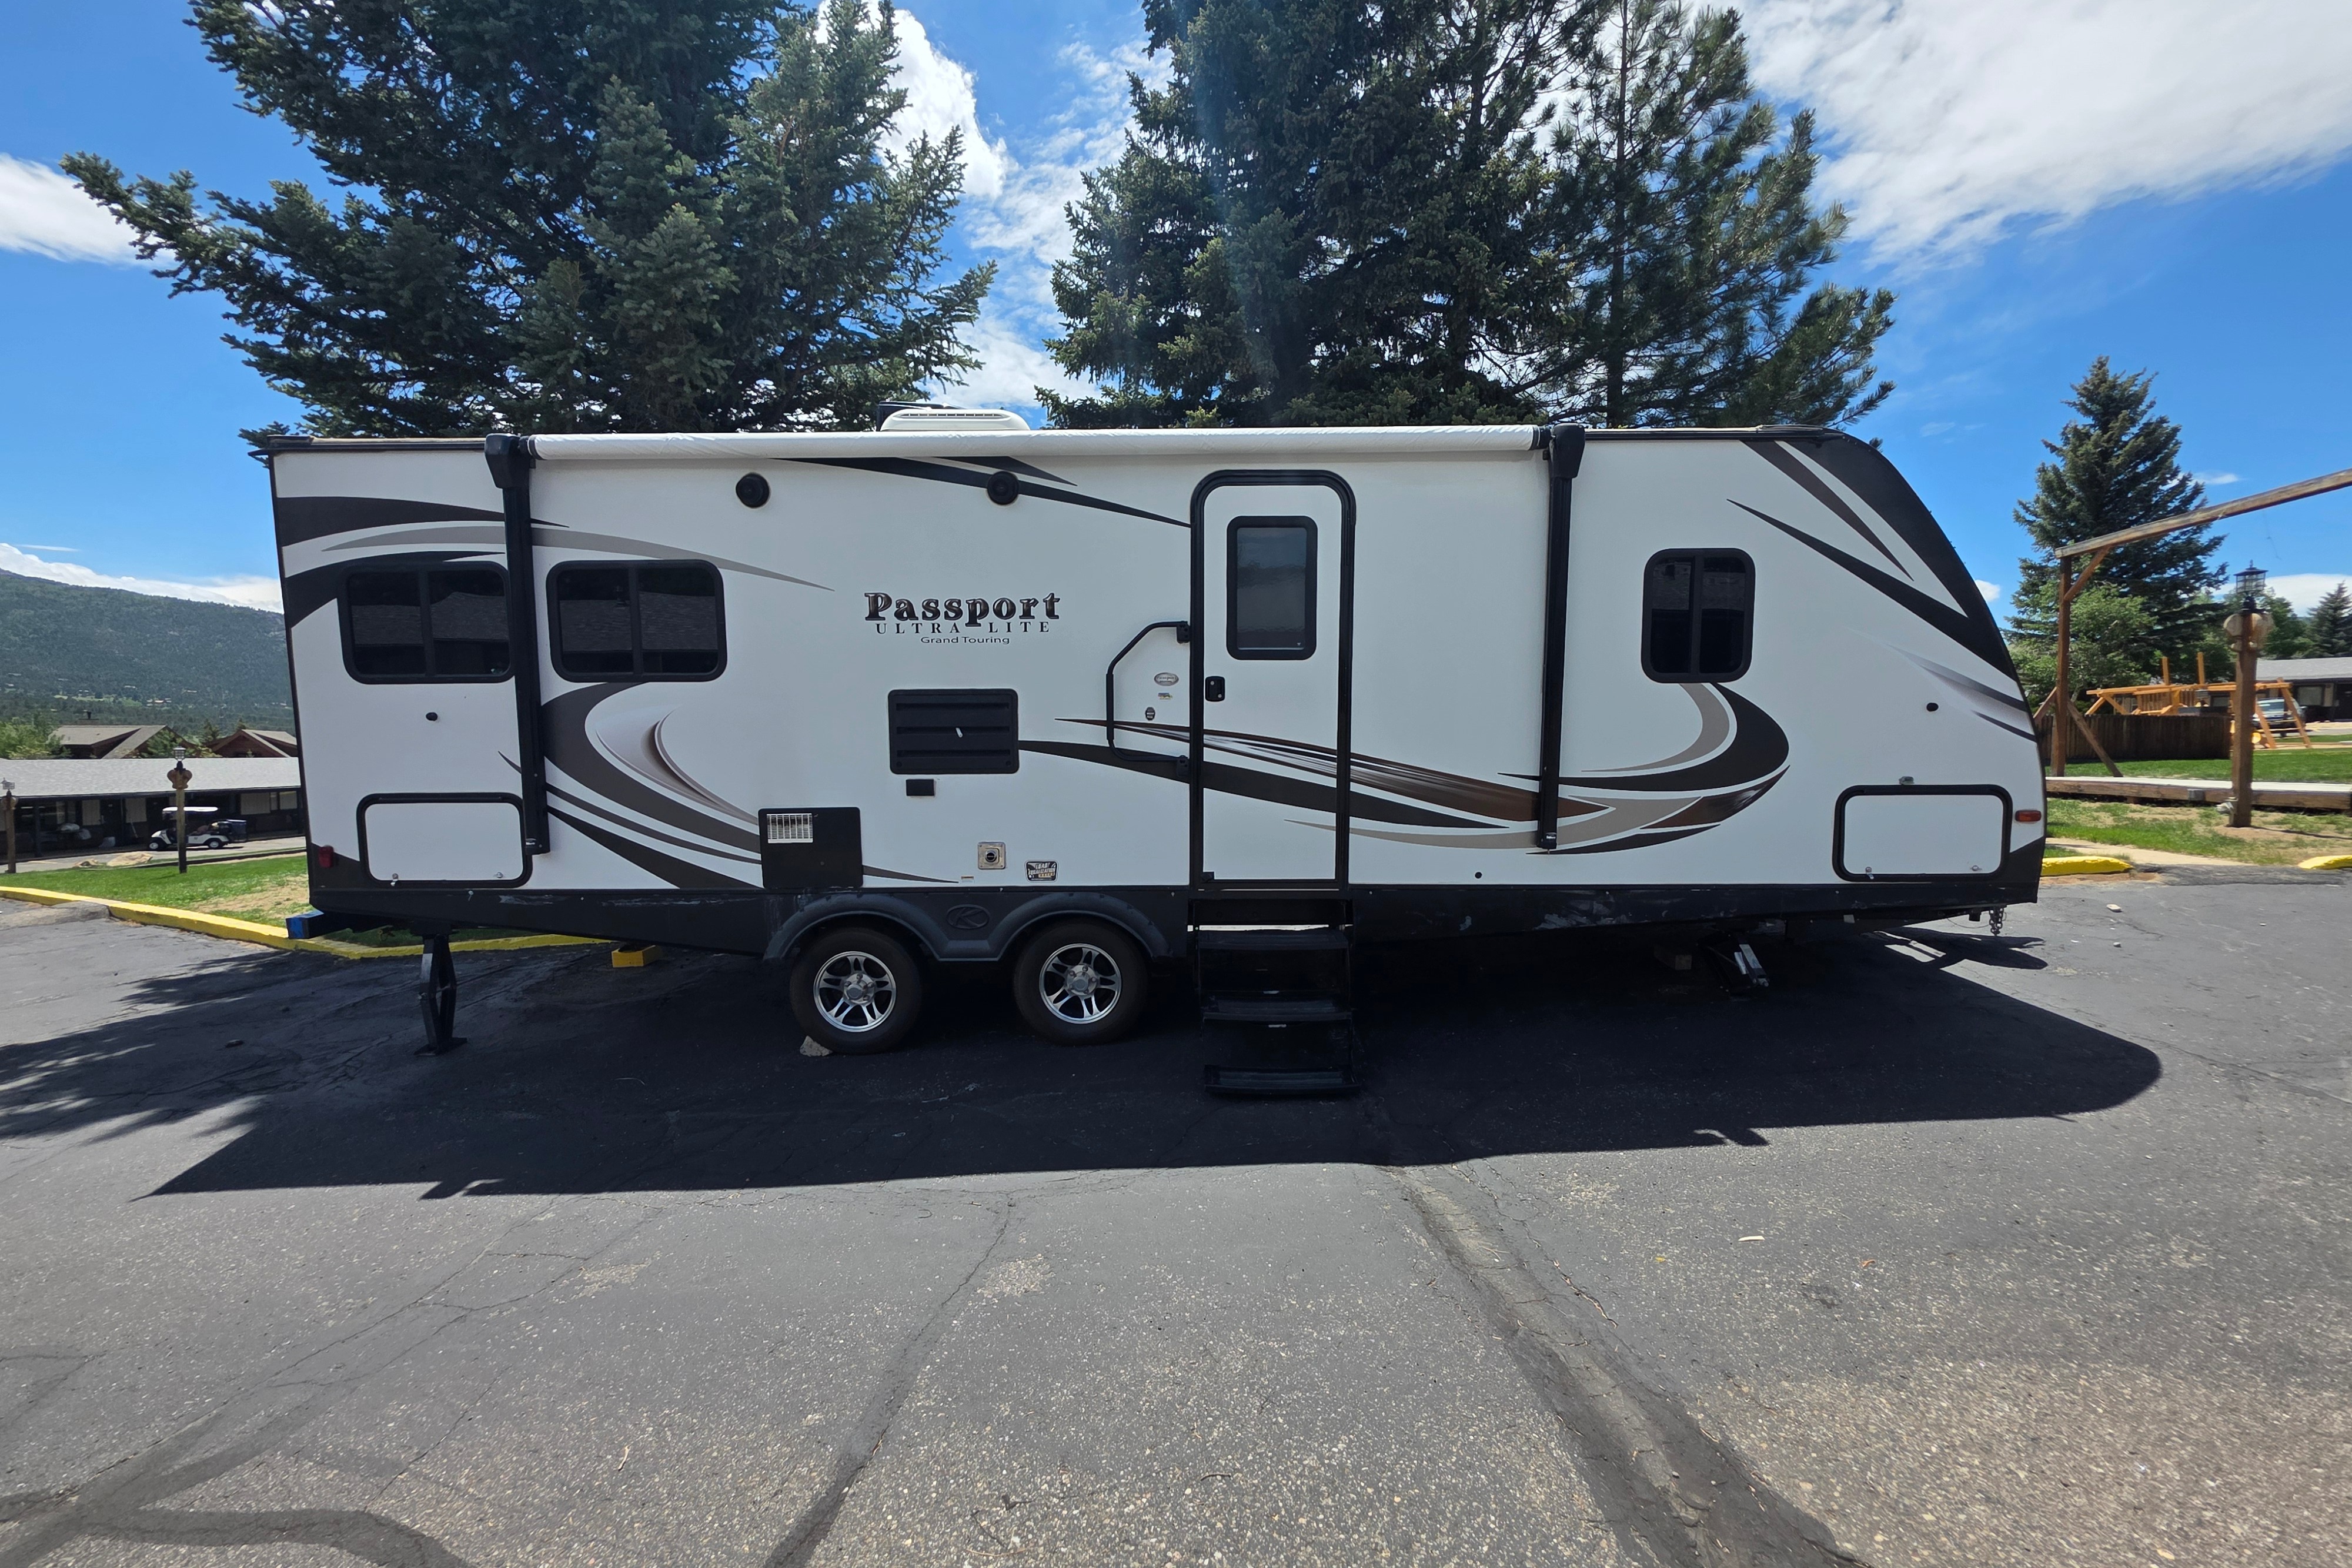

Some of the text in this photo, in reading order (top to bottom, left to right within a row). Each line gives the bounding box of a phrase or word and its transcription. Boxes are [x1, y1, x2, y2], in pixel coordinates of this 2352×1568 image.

[864, 592, 1061, 627] Passport
[876, 621, 1050, 634] ULTRA LITE
[961, 636, 1010, 645] Touring
